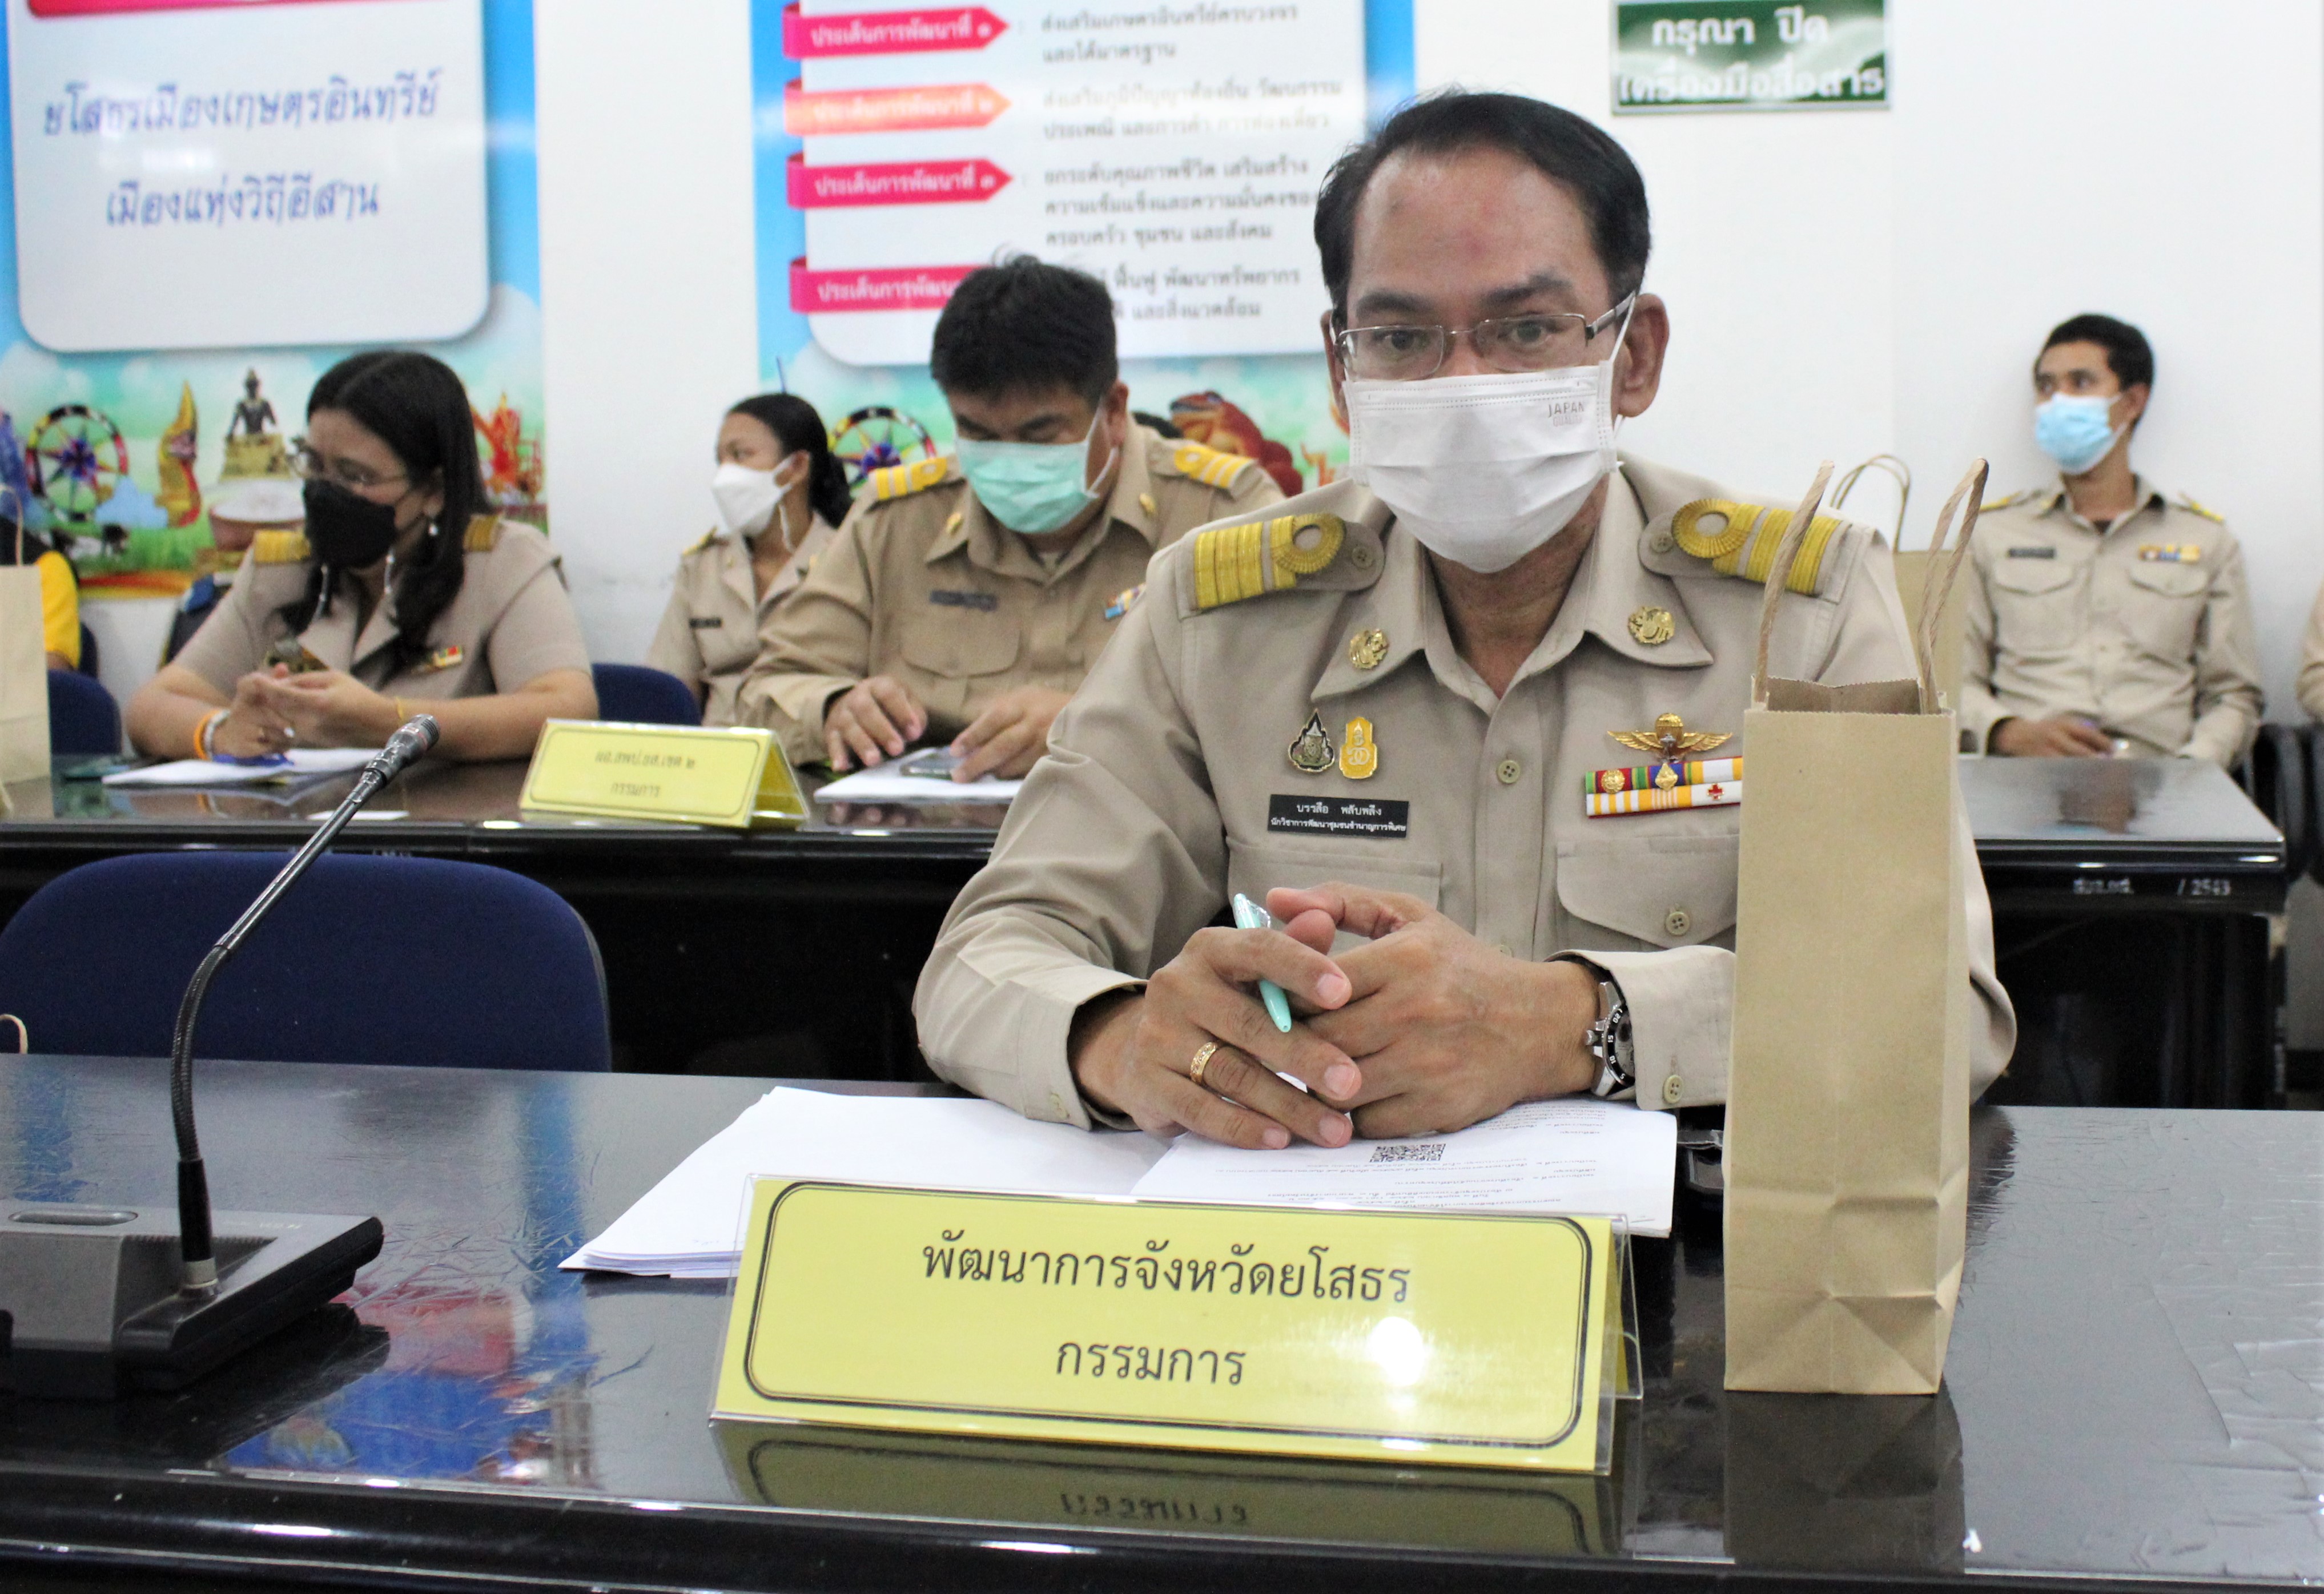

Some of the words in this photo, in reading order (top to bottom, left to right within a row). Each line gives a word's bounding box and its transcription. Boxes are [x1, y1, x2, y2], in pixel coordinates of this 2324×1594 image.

[1652, 17, 1755, 56] กรุณา
[1775, 5, 1829, 43] ปิด
[1619, 54, 1884, 102] เครื่องมือสื่อสาร
[105, 172, 379, 227] เมืองแห่งวิถีอีสาน
[1548, 401, 1584, 418] JAPAN
[1607, 1035, 1614, 1043] 15
[1609, 1055, 1617, 1064] 10
[922, 1229, 1411, 1303] พัฒนาการจังหวัดยโสธร
[1056, 1341, 1246, 1386] กรรมการ
